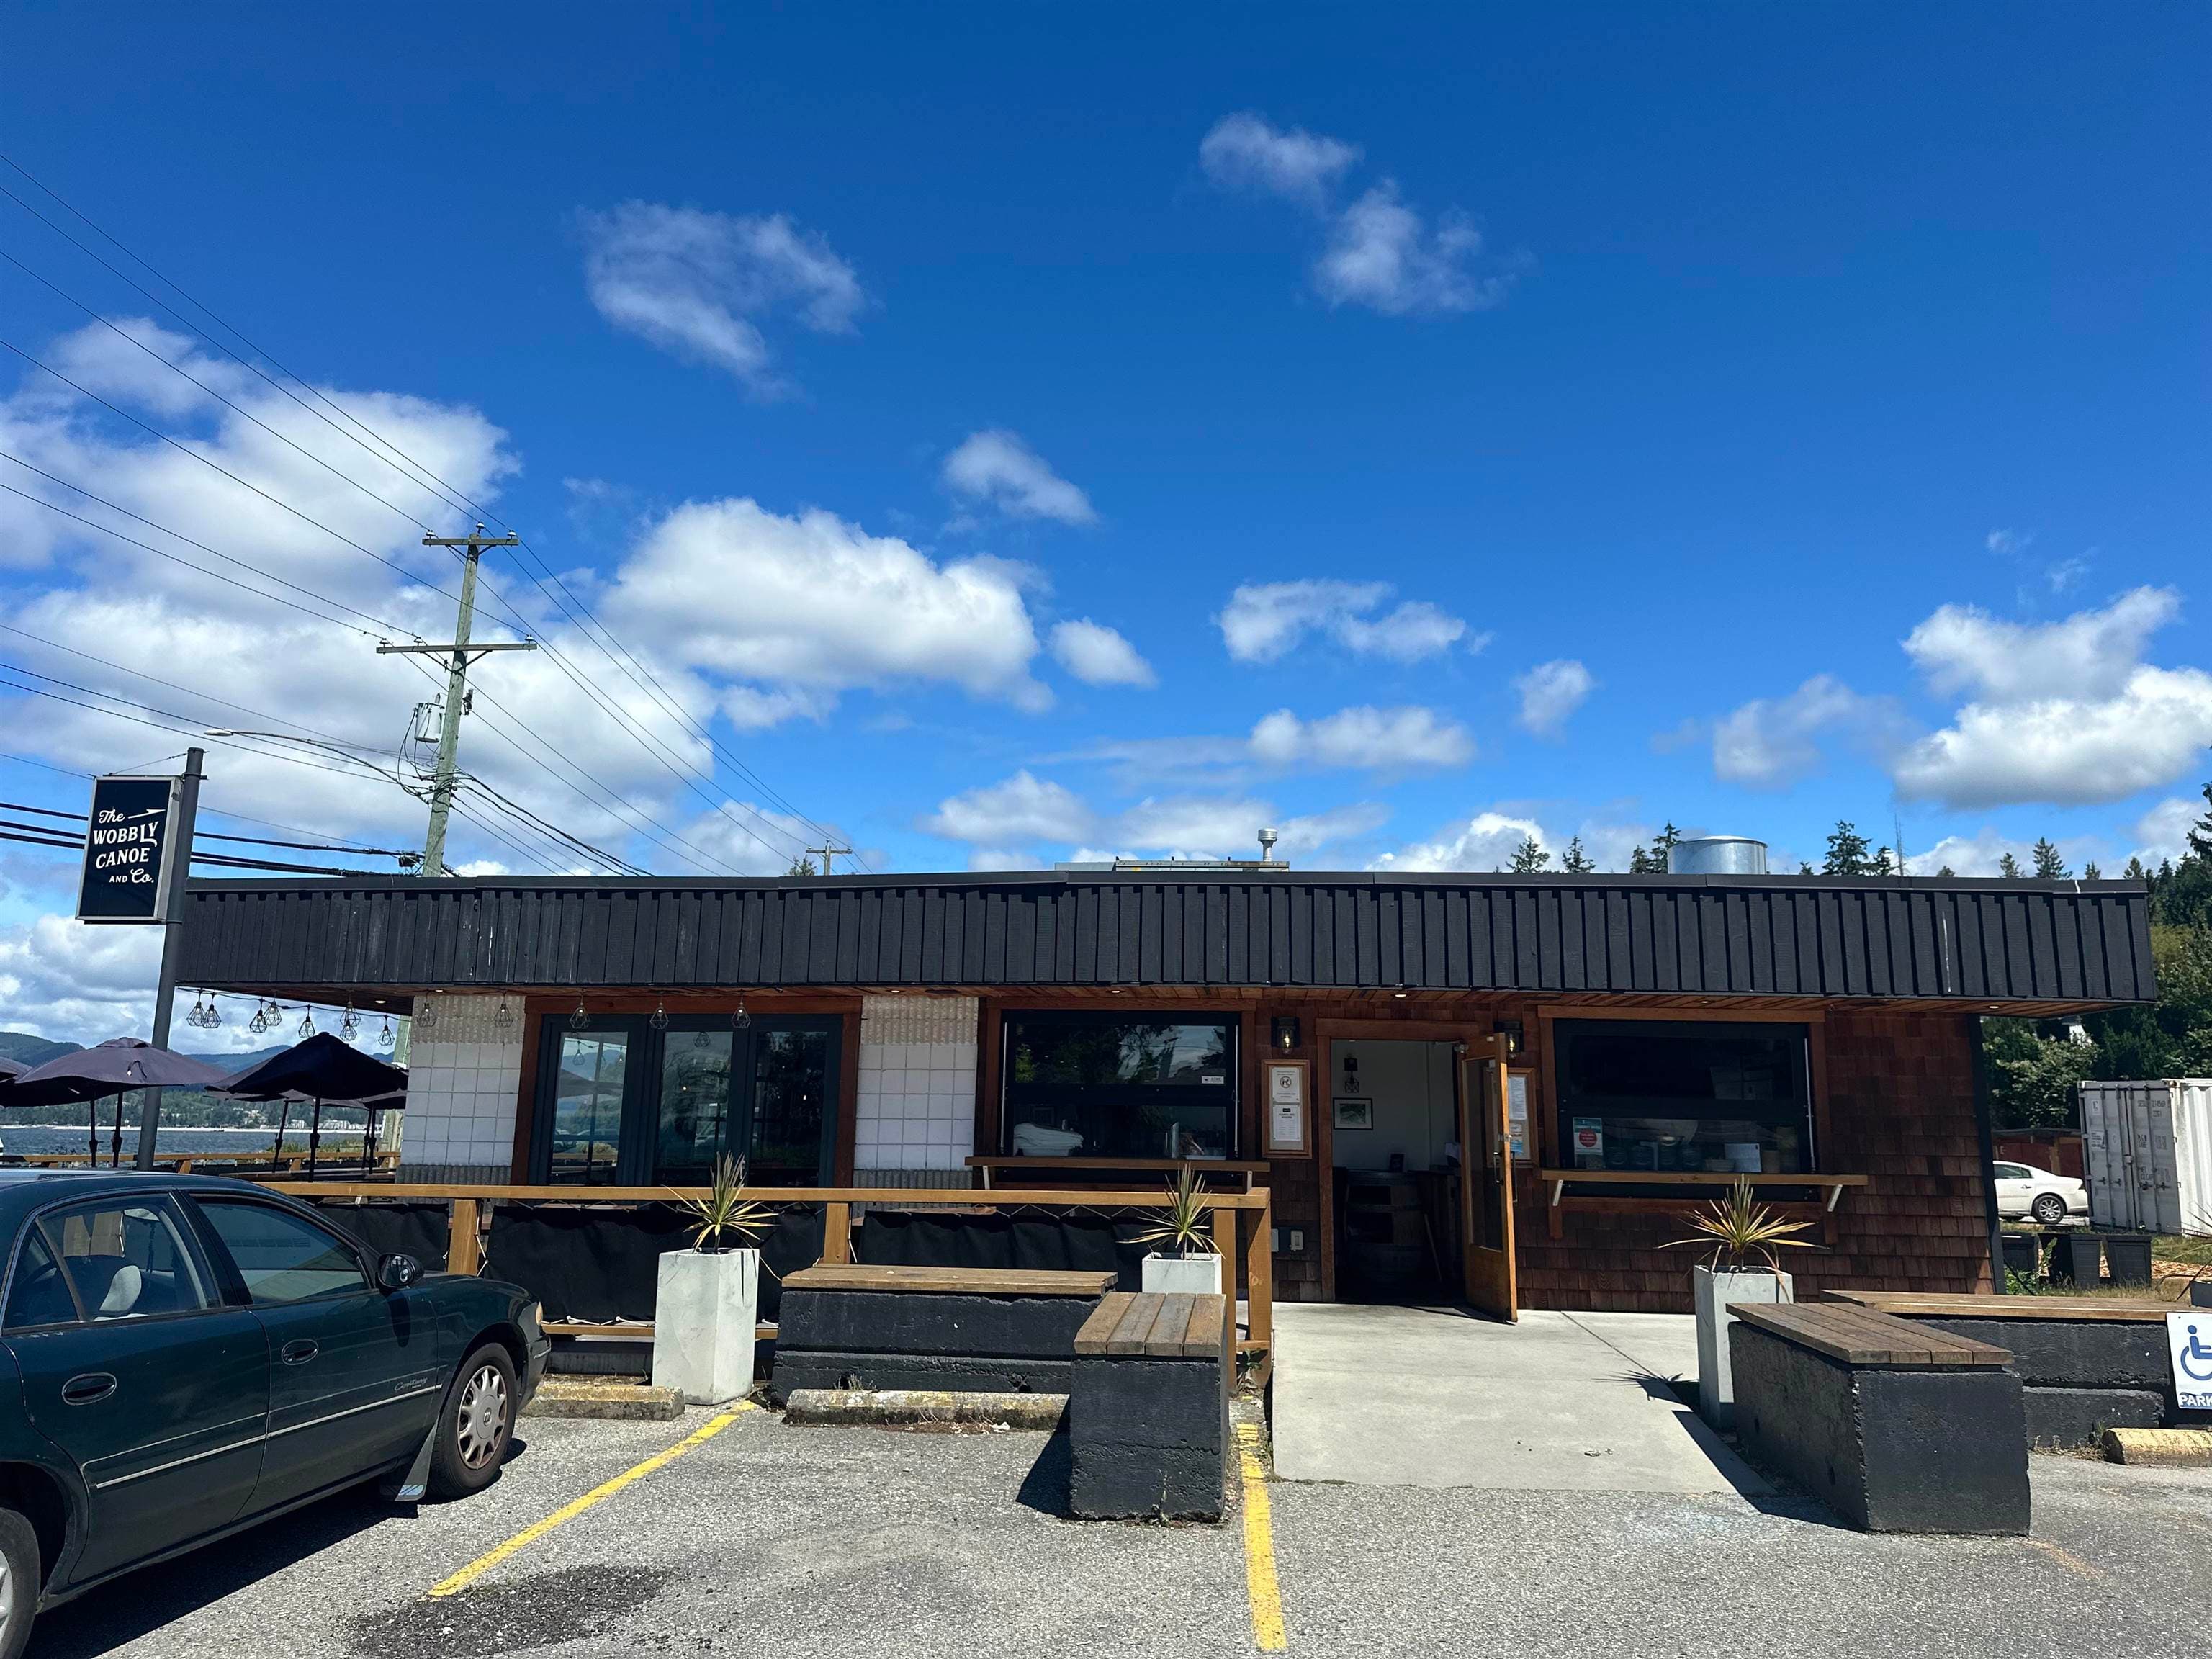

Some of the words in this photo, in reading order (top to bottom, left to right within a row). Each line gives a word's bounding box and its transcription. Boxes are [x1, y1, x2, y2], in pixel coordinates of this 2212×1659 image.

[99, 809, 125, 824] The
[93, 821, 159, 848] WOBBLY
[96, 847, 150, 869] CANOE
[130, 868, 155, 884] Co.
